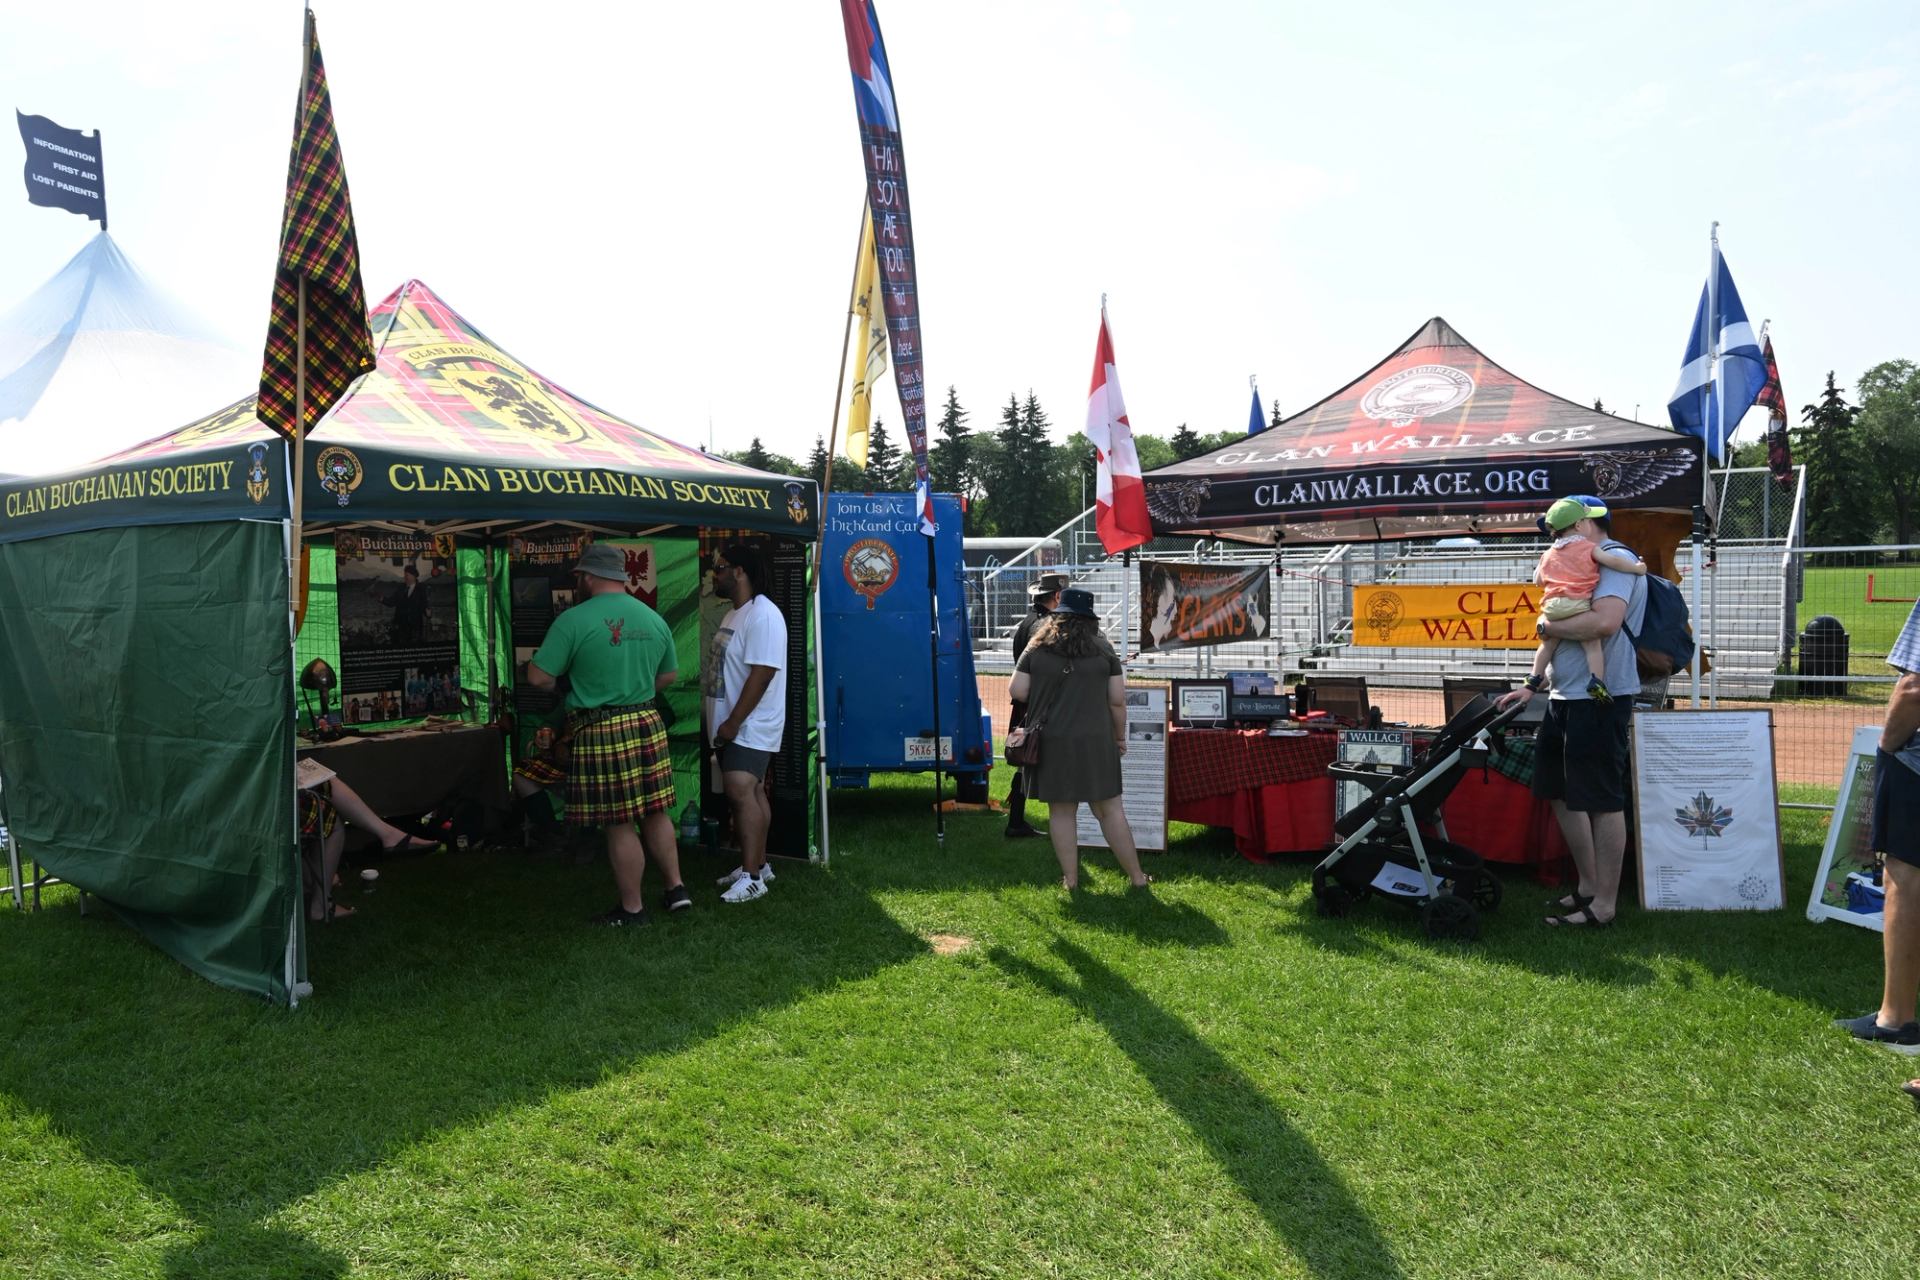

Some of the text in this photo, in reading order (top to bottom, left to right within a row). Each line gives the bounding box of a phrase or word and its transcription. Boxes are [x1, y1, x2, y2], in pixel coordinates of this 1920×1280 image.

[33, 137, 96, 163] INFORMATION
[53, 162, 98, 181] FIRST AID
[32, 173, 99, 199] LOST PARENTS
[408, 347, 447, 360] CLAN
[1215, 425, 1597, 466] CLAN WALLACE
[6, 460, 235, 519] CLAN BUCHANAN SOCIETY
[388, 463, 773, 511] CLAN BUCHANAN SOCIETY
[1254, 469, 1551, 507] CLANWALLACE.ORG
[837, 503, 861, 516] Join
[865, 502, 882, 514] Us
[832, 517, 891, 536] Highland
[360, 537, 433, 551] Buchanan
[526, 541, 576, 554] Buchanan
[1457, 591, 1542, 615] CLA
[1177, 592, 1246, 640] CLANS
[1420, 618, 1540, 641] WALL
[1350, 732, 1401, 743] WALLACE
[909, 744, 948, 756] 5KX6-6
[1856, 760, 1874, 773] Sir
